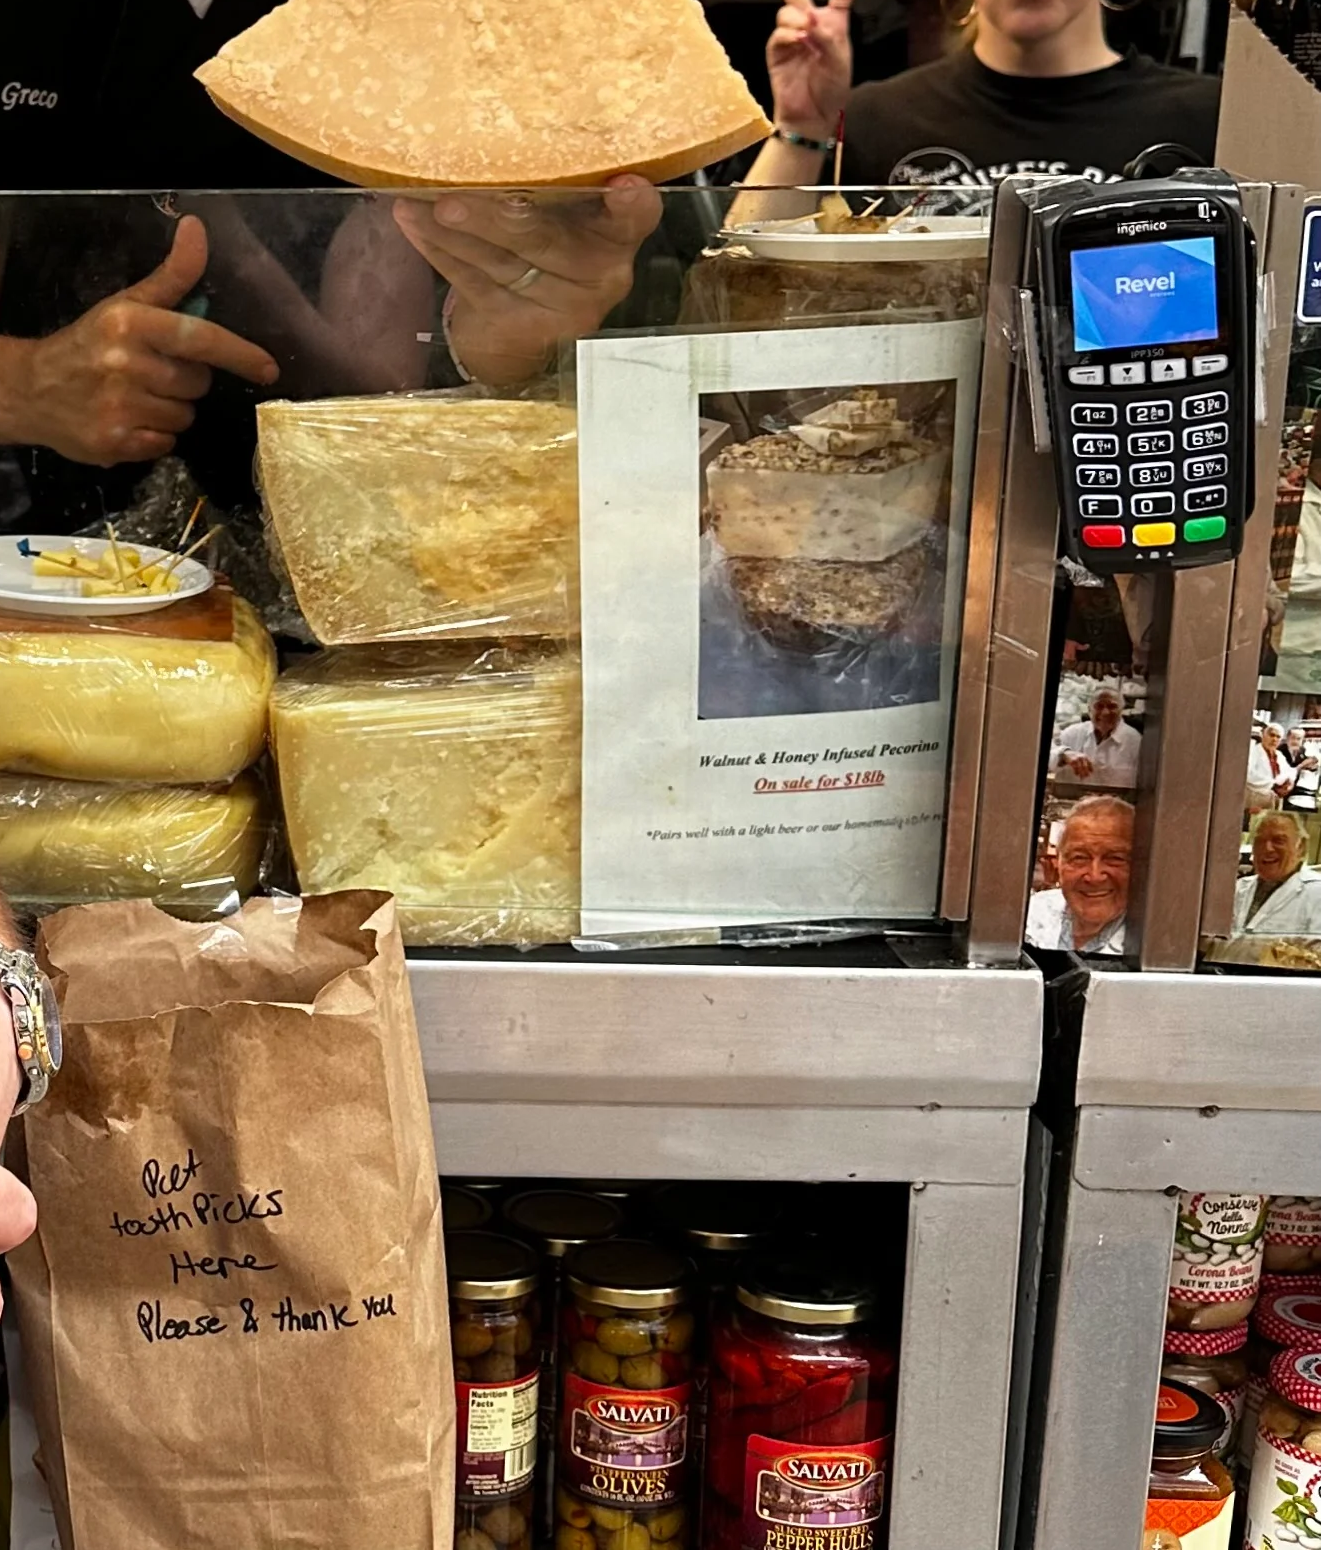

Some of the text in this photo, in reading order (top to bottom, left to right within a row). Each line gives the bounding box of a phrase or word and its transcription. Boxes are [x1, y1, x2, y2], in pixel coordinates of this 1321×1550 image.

[1, 81, 58, 111] Greco
[1117, 220, 1167, 236] ingenico
[1115, 271, 1175, 295] Revel
[1193, 400, 1205, 414] 3
[1082, 409, 1091, 422] 1
[1136, 408, 1149, 421] 2
[1138, 438, 1149, 451] 5
[1192, 432, 1204, 446] 6
[1083, 440, 1095, 453] 4
[1139, 469, 1151, 482] 8
[1192, 463, 1204, 476] 9
[1084, 471, 1096, 483] 7
[1088, 501, 1098, 514] F
[699, 740, 940, 767] Walnut & Honey Infused Pecorino
[754, 769, 885, 792] On sale for $18lb
[685, 827, 709, 838] well
[712, 826, 735, 837] with
[738, 828, 746, 836] a
[749, 823, 776, 838] light
[778, 823, 804, 835] beer
[806, 825, 819, 833] or
[821, 823, 841, 831] our
[142, 1149, 202, 1198] Put
[1207, 1220, 1252, 1235] Nonna
[169, 1251, 278, 1284] Here
[1188, 1266, 1226, 1278] Corona
[1180, 1278, 1196, 1288] NET
[137, 1300, 228, 1343] Please
[239, 1297, 259, 1333] &
[271, 1296, 359, 1331] thank
[471, 1390, 507, 1399] Nutrition
[471, 1399, 494, 1408] Facts
[597, 1400, 670, 1423] SALVATI
[590, 1464, 669, 1481] STUFFED QUEEN
[787, 1459, 865, 1480] SALVATI
[592, 1474, 667, 1496] OLIVES
[774, 1524, 869, 1538] SLICED SWEET RED
[766, 1530, 874, 1550] PEPPER HULLS
